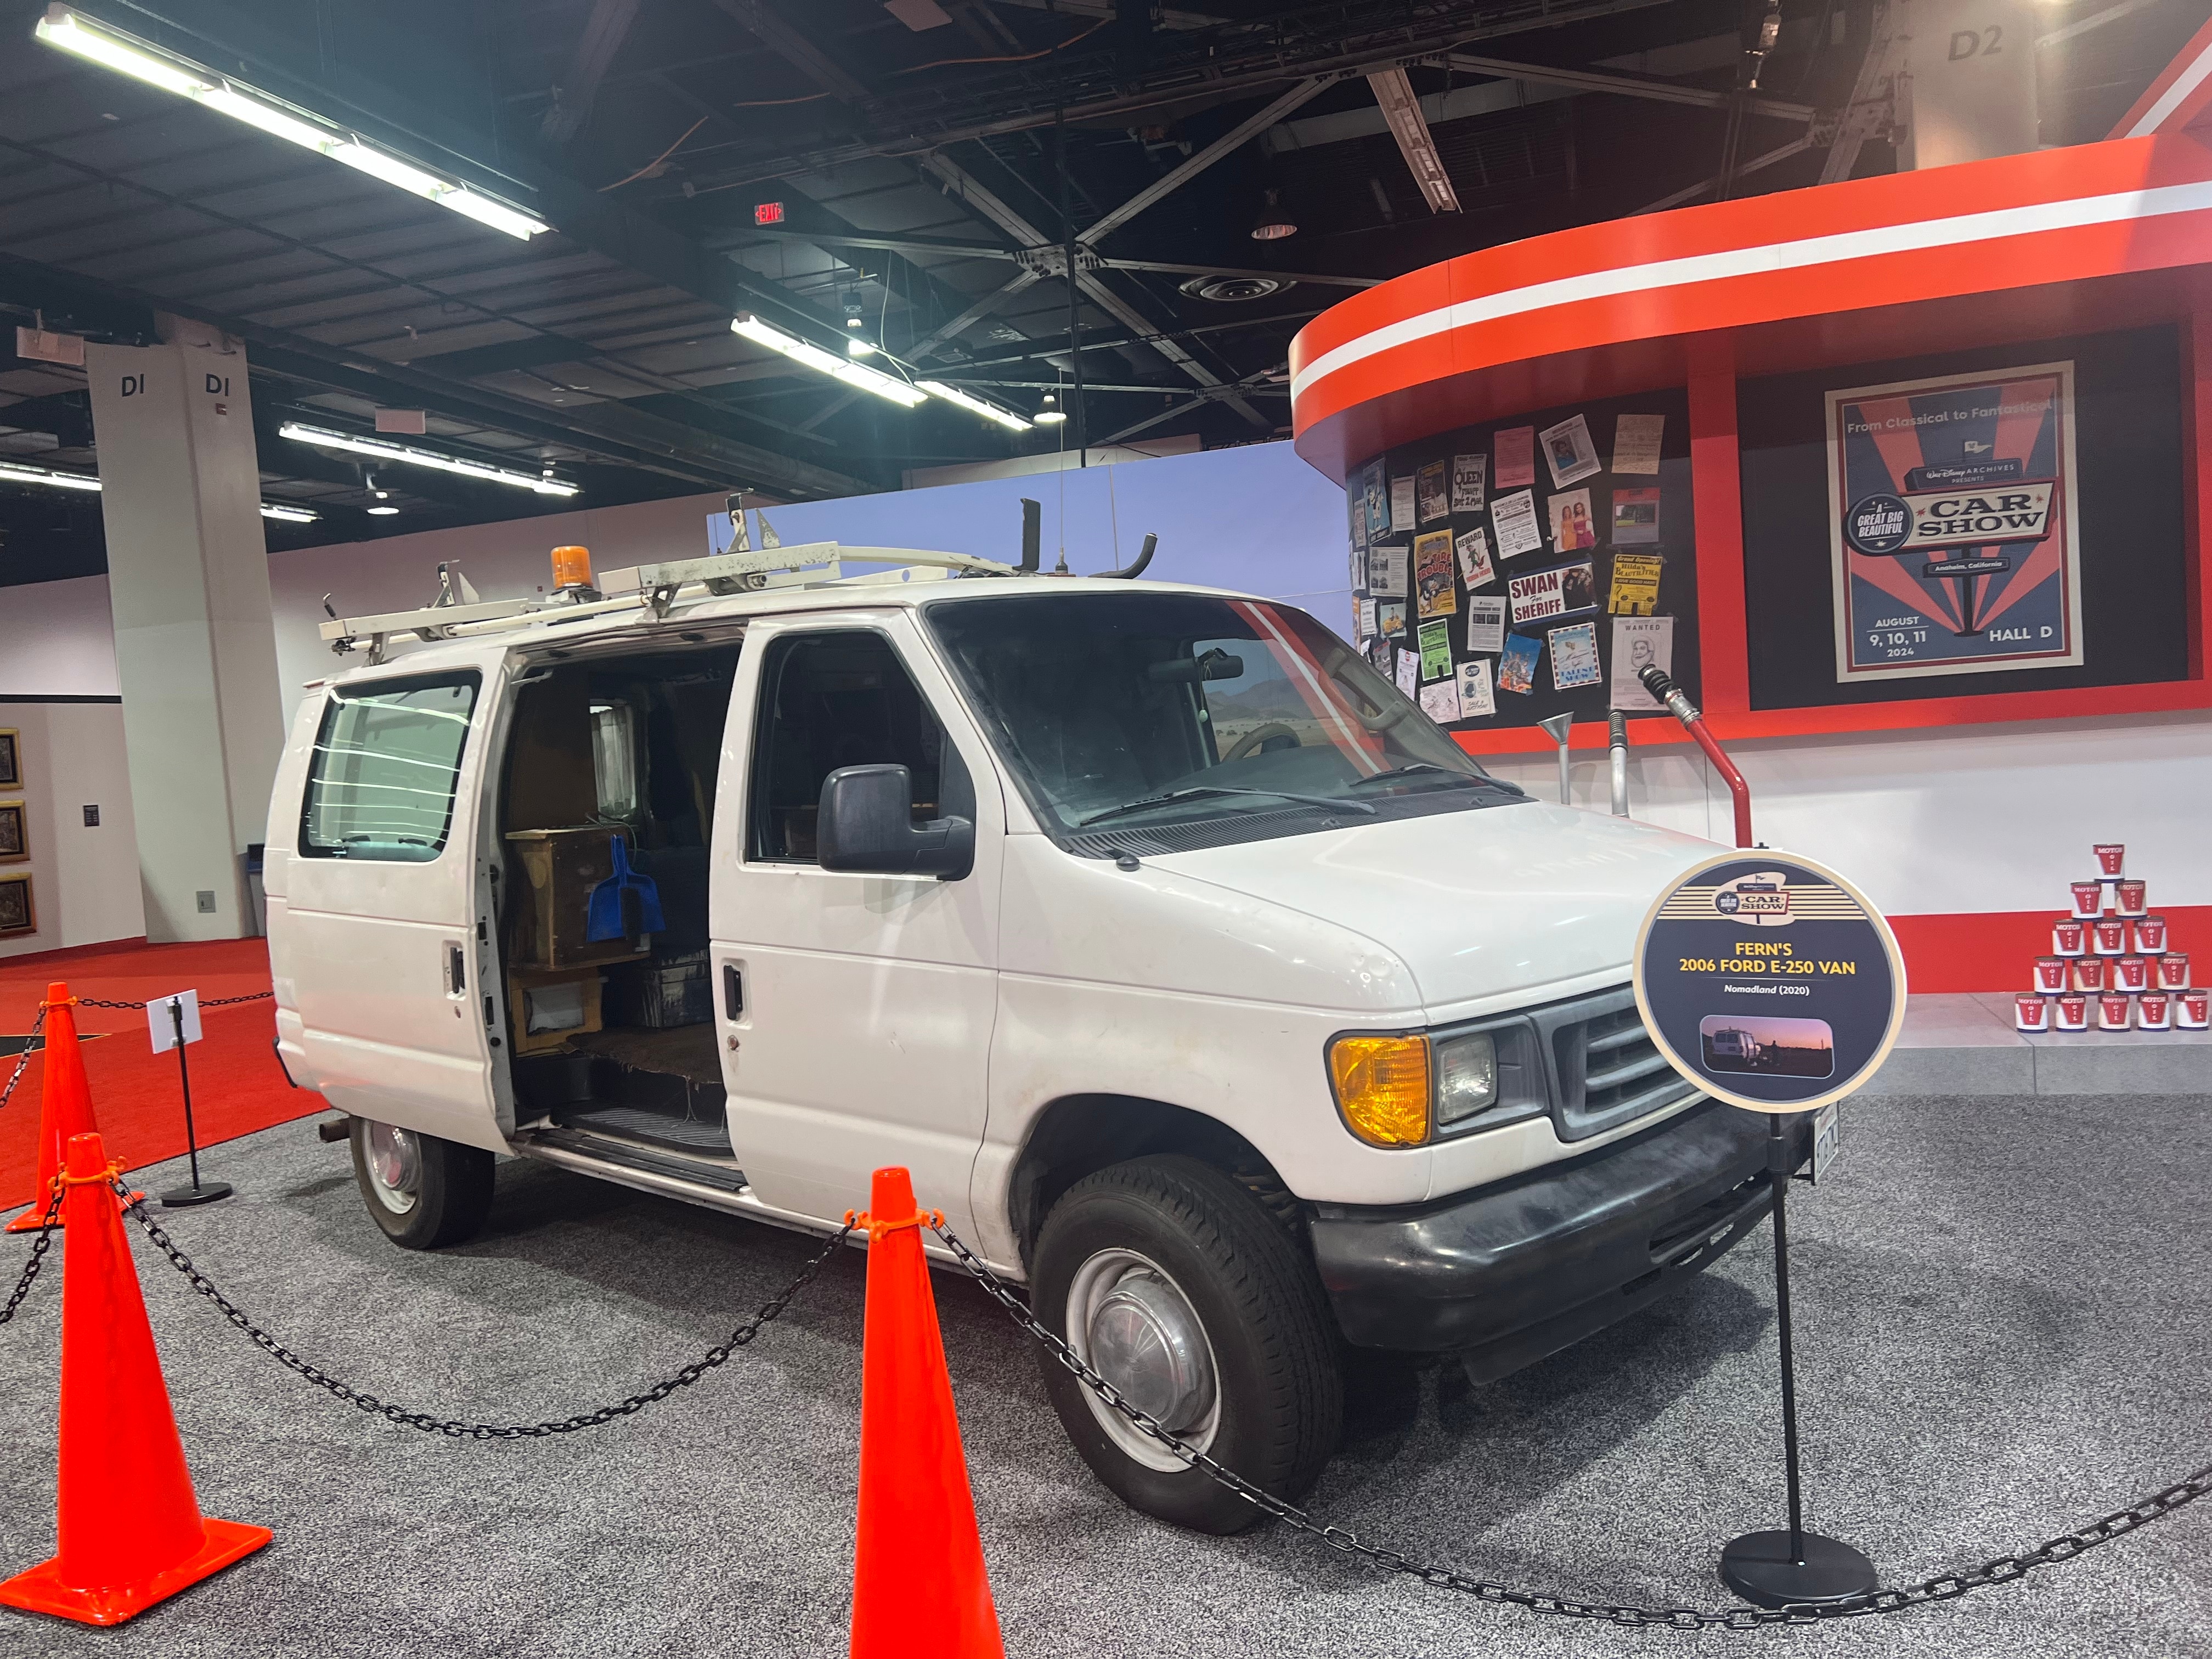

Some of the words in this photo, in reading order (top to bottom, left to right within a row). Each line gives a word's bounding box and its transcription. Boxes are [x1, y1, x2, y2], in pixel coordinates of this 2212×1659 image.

[1948, 25, 2002, 61] D2
[759, 203, 778, 222] EXIT
[1848, 422, 1881, 434] From
[1886, 411, 1949, 428] Classical
[1953, 411, 1967, 420] to
[1972, 399, 2052, 418] Fantastical
[1967, 464, 2015, 474] ARCHIVES
[1454, 470, 1483, 487] QUEEN
[1876, 503, 1882, 513] A
[1930, 494, 2032, 518] CAR
[1857, 513, 1886, 527] GREAT
[1887, 511, 1904, 523] BIG
[1918, 512, 2044, 537] SHOW
[1858, 522, 1903, 537] BEAUTIFUL
[1458, 531, 1482, 549] REWARD
[1431, 551, 1452, 563] TIRE
[1968, 561, 2002, 569] California
[1417, 561, 1453, 582] TROUBLE
[1511, 572, 1559, 599] SWAN
[1530, 595, 1542, 603] For
[1514, 599, 1561, 620] SHERIFF
[1875, 616, 1920, 628] AUGUST
[1869, 635, 1883, 648] 9,
[1887, 633, 1909, 646] 10,
[1914, 631, 1926, 643] 11
[1989, 627, 2032, 642] HALL
[2040, 626, 2053, 638] D
[1887, 647, 1914, 657] 2024
[1561, 667, 1592, 676] TALENT
[1735, 942, 1793, 956] FERN'S
[1679, 958, 1716, 972] 2006
[1720, 959, 1766, 973] FORD
[1770, 960, 1814, 974] E-250
[1818, 961, 1855, 975] VAN
[1724, 984, 1777, 994] Nomadland
[1779, 985, 1810, 996] (2020)
